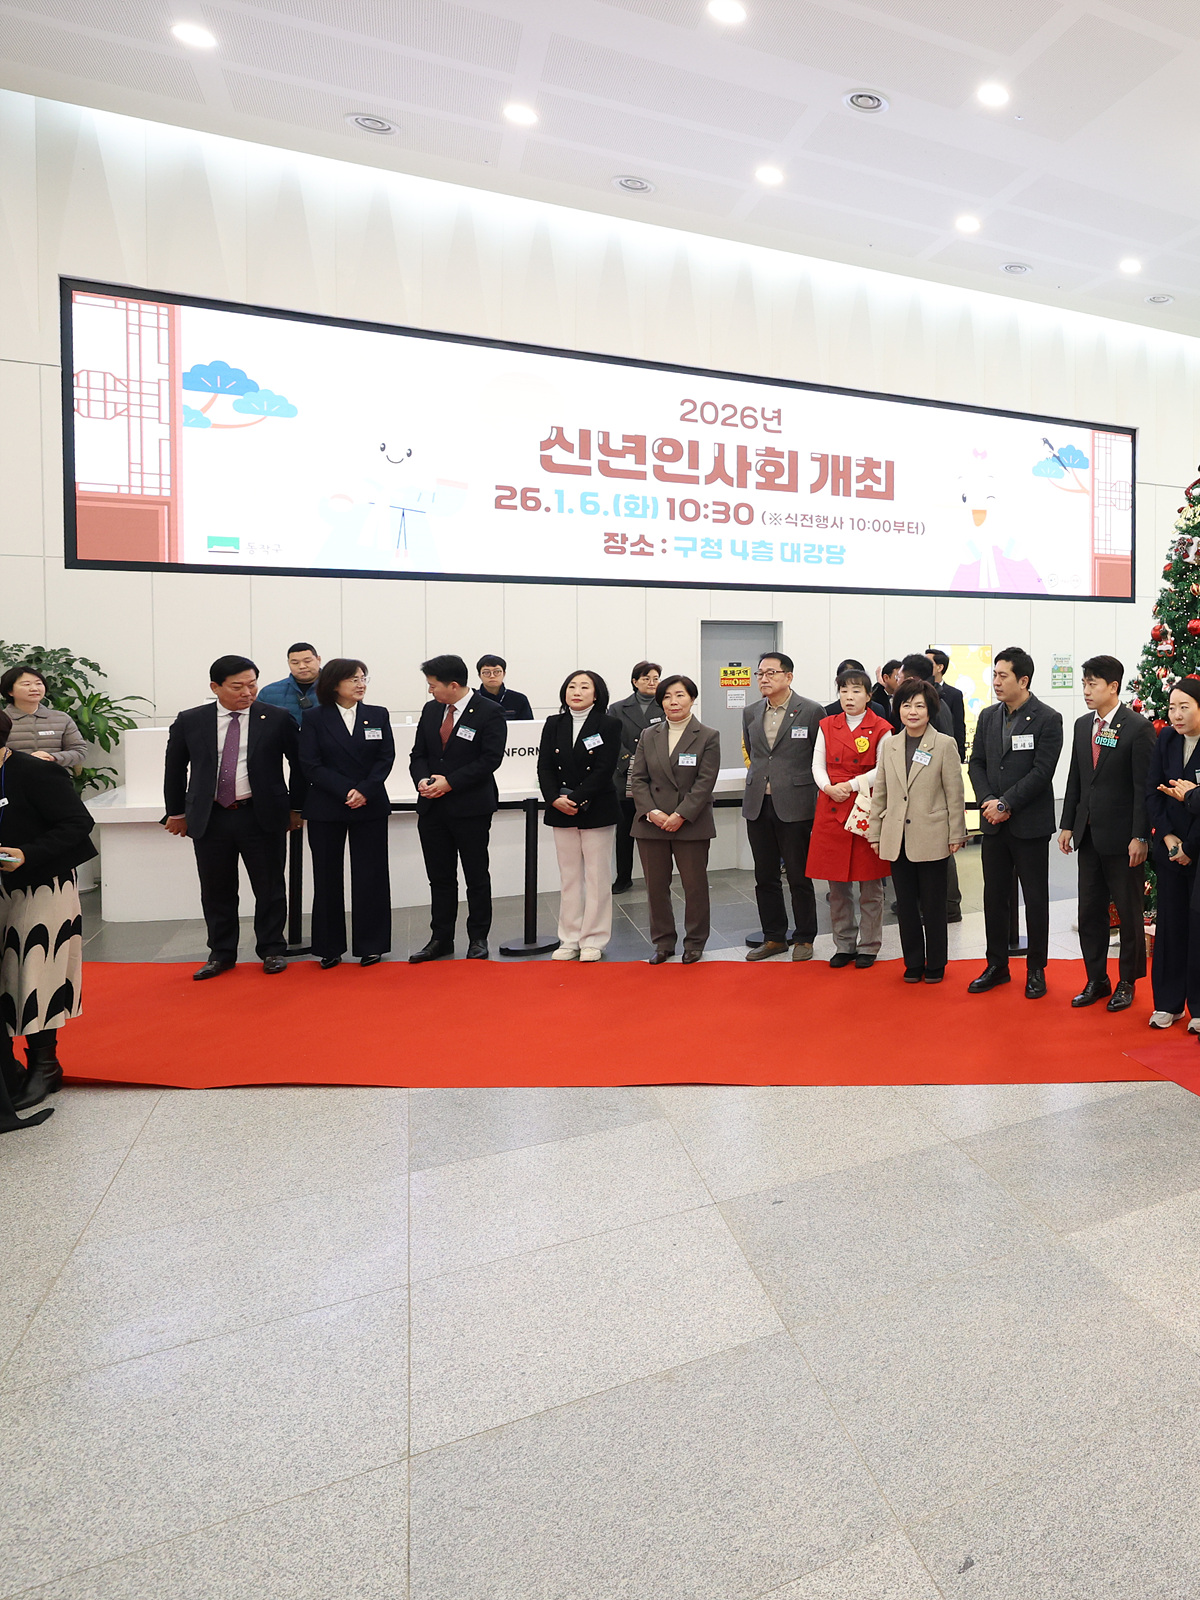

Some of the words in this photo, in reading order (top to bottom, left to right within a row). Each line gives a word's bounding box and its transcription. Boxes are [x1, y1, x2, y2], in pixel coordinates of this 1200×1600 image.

[679, 398, 783, 434] 2026년
[539, 425, 799, 494] 신년인사회
[809, 451, 895, 502] 개최
[666, 496, 755, 527] 10:30
[848, 516, 927, 537] 10:00부터)
[602, 531, 655, 557] 장소
[673, 535, 724, 561] 구청
[730, 538, 775, 563] 4층
[780, 541, 847, 566] 대강당
